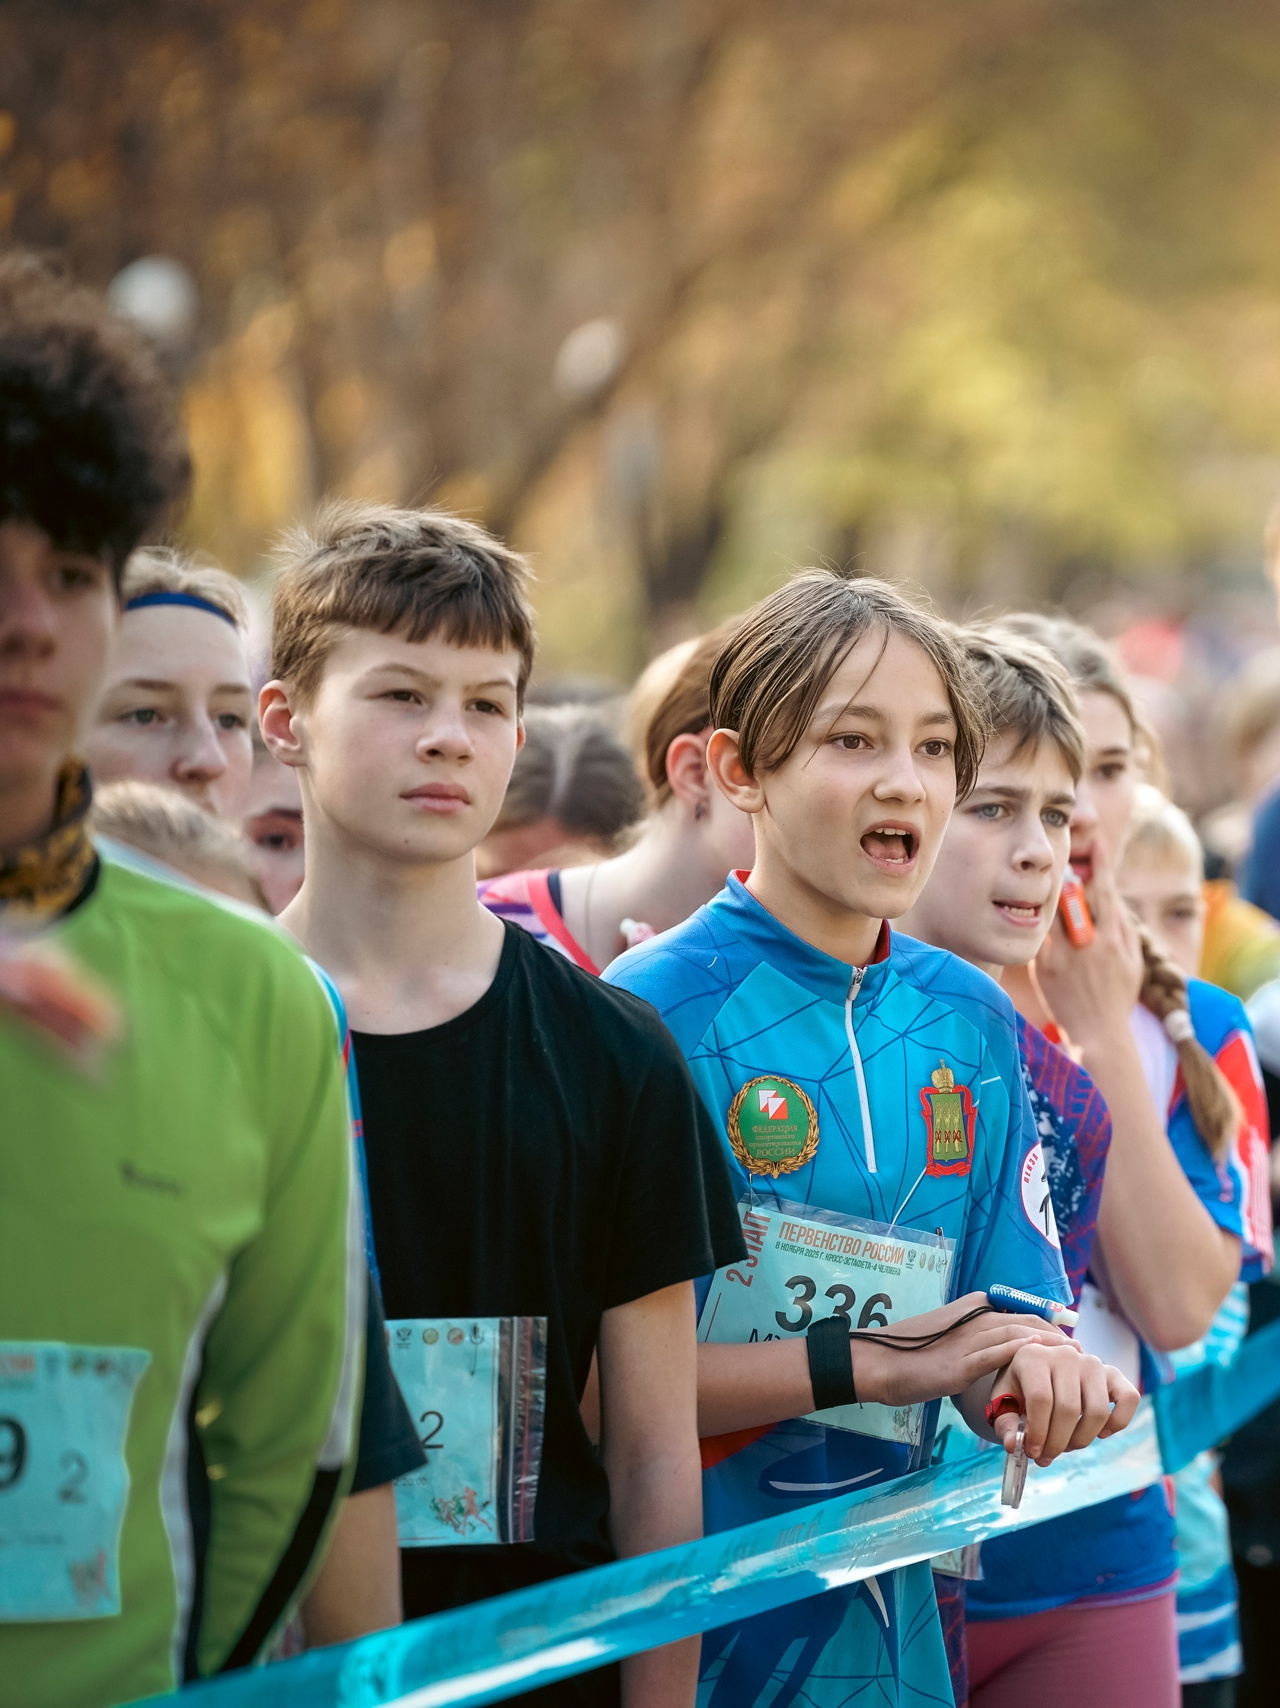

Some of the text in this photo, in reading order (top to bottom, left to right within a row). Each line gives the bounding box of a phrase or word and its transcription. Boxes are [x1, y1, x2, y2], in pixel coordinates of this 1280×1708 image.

[752, 1125, 798, 1133] ФЕДЕРАЦИЯ
[757, 1148, 795, 1156] РОССИИ
[1023, 1152, 1039, 1184] ПЕНЗА
[725, 1210, 771, 1288] 2 ЭАП
[775, 1241, 781, 1250] 8
[780, 1243, 804, 1256] НОЯБРЯ
[804, 1248, 820, 1259] 2025
[877, 1264, 901, 1277] ЧЕЛОВЕКА
[778, 1221, 906, 1266] ПЕРВЕНСТВО РОССИИ
[775, 1275, 893, 1332] 336
[420, 1410, 445, 1450] 2
